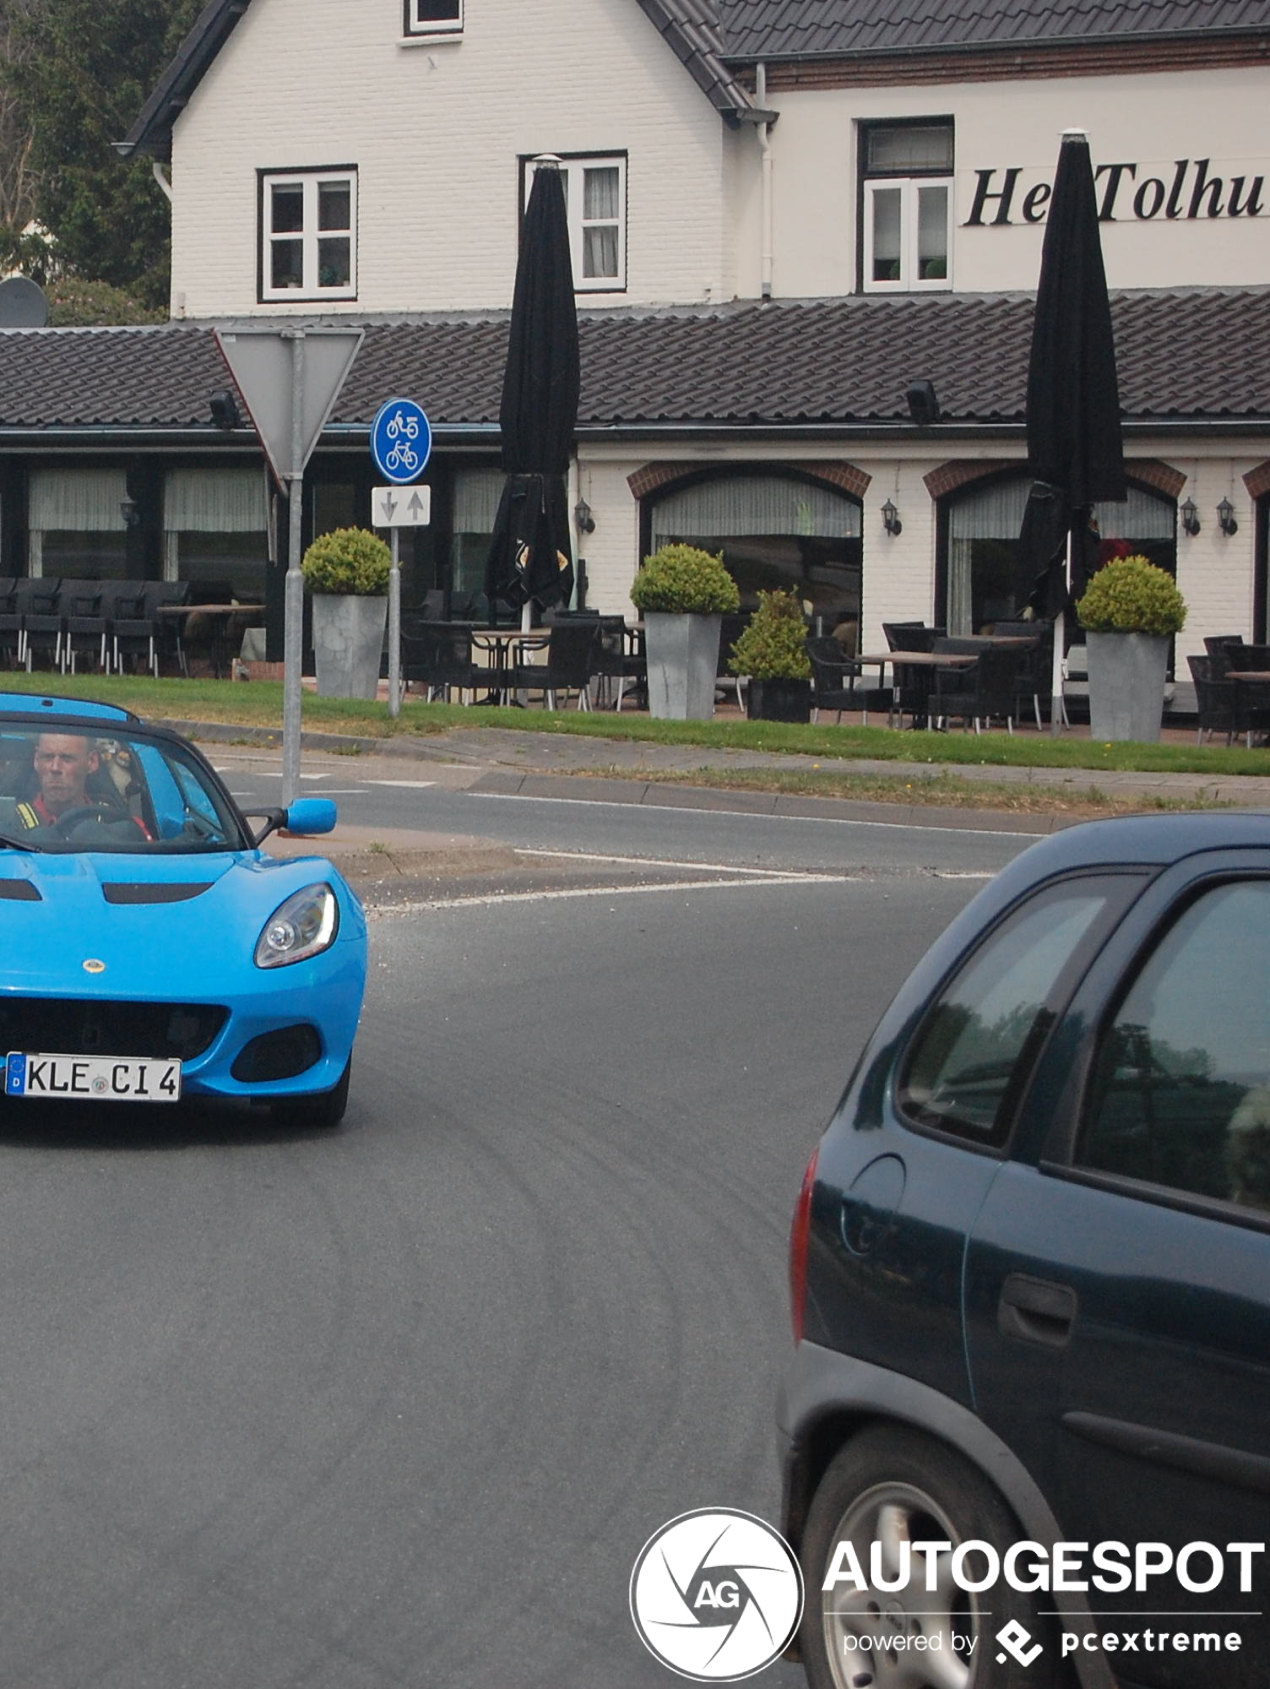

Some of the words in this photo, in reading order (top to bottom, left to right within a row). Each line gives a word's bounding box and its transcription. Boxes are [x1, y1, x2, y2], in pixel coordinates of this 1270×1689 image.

[962, 167, 1051, 226] He
[1094, 158, 1265, 221] Tolhu
[13, 1077, 20, 1088] D
[28, 1061, 90, 1093] KLE
[111, 1065, 149, 1095] CI
[159, 1066, 176, 1095] 4
